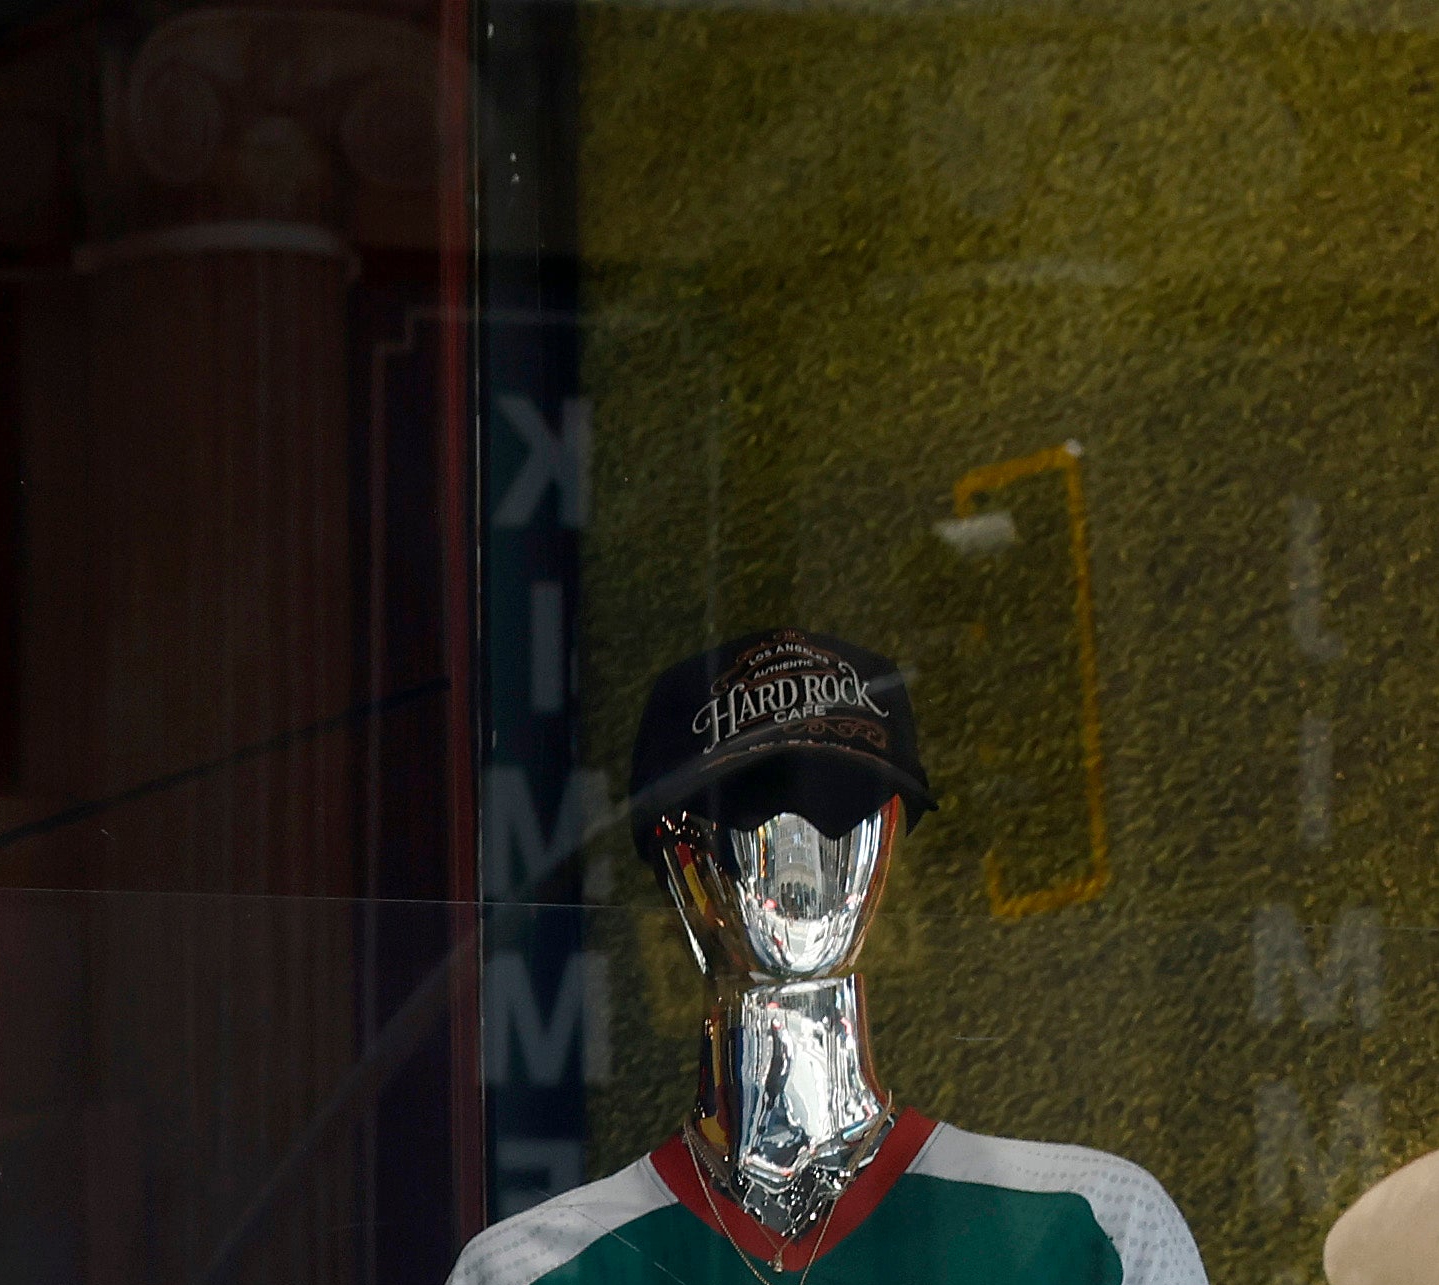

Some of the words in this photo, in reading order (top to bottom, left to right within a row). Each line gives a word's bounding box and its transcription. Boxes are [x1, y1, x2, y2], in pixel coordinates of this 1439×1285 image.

[748, 648, 772, 667] LOS
[775, 641, 829, 665] ANGELES
[753, 659, 814, 679] AUTHENTIC
[691, 675, 800, 755] HARD
[801, 661, 890, 718] ROCK
[773, 704, 827, 724] CAFE
